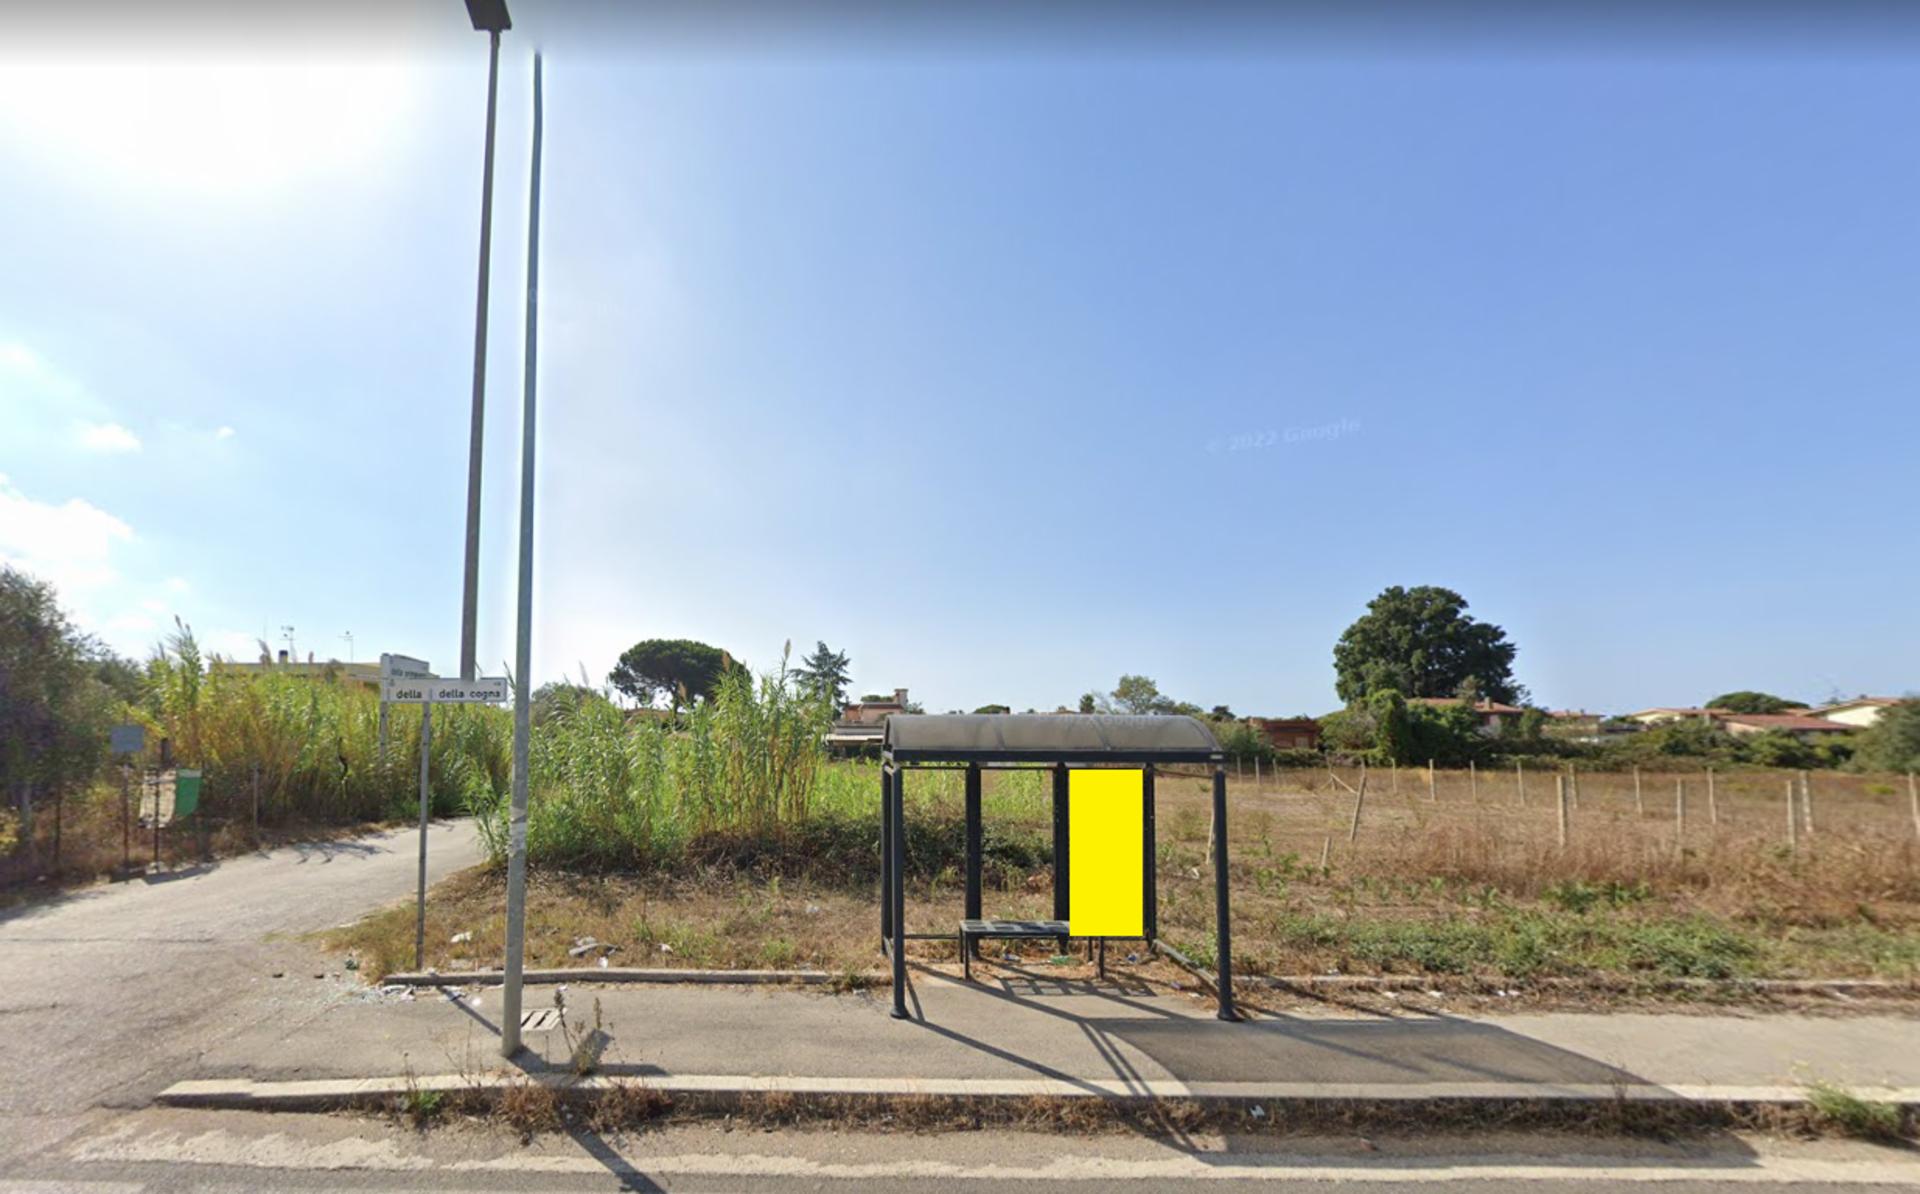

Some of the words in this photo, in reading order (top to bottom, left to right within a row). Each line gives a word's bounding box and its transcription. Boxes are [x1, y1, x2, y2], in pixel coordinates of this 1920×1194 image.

[396, 688, 422, 699] della
[439, 688, 464, 699] della
[469, 690, 500, 700] cogna
